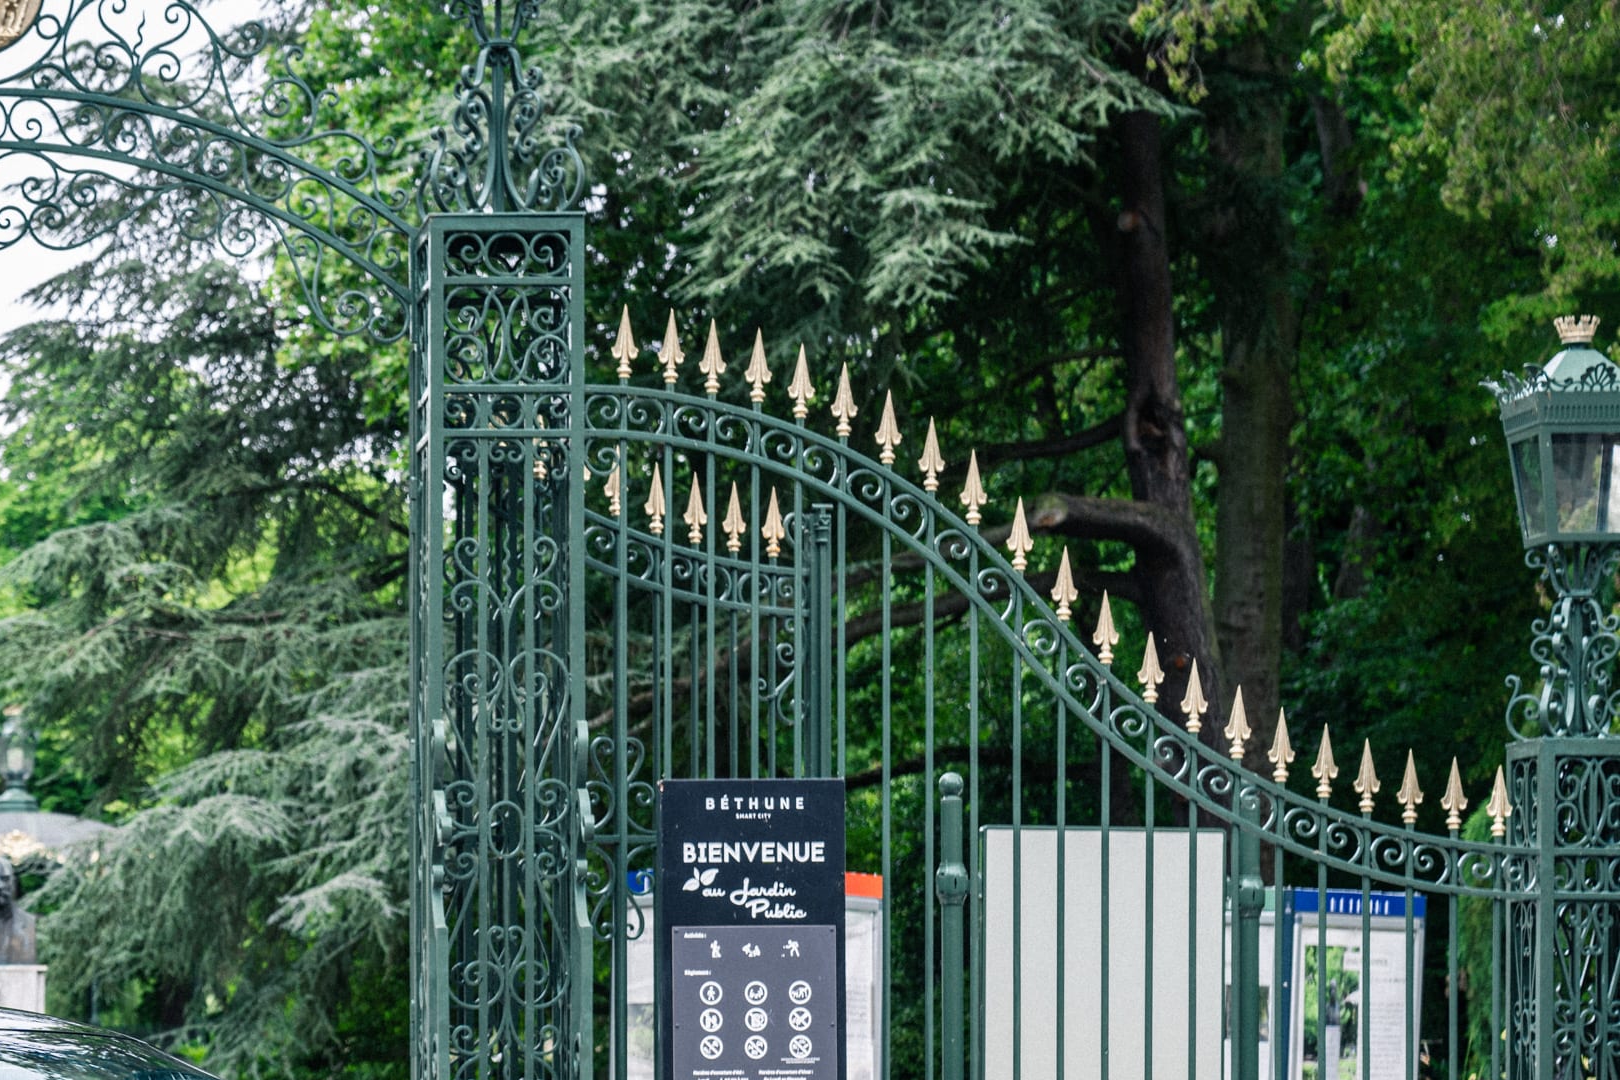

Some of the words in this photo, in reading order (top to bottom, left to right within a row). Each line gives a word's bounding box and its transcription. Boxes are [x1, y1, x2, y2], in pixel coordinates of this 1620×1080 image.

[705, 794, 805, 810] BÉTHUNE
[683, 841, 825, 863] BIENVENUE
[702, 887, 726, 897] au
[729, 877, 796, 906] Jardin
[745, 898, 807, 919] Public
